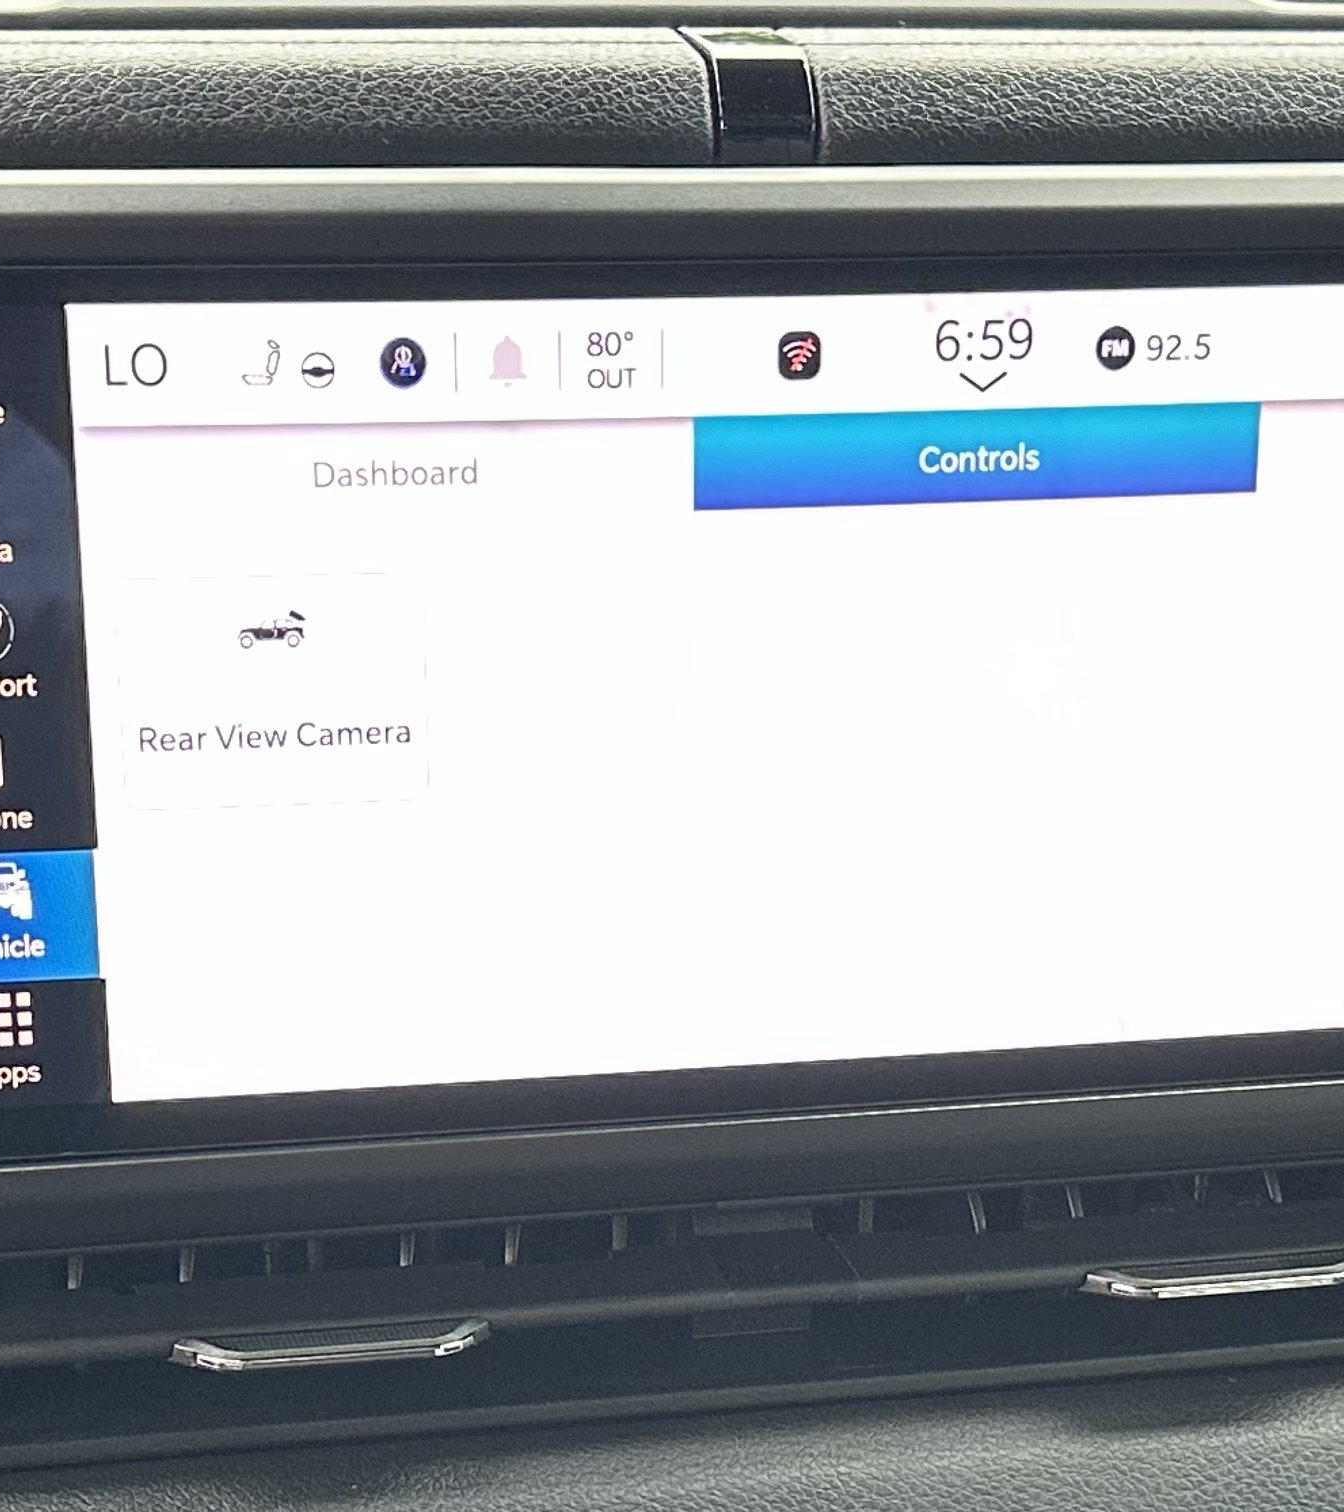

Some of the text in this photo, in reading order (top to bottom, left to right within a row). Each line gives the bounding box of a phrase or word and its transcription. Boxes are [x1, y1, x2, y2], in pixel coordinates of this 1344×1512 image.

[585, 330, 635, 358] 80°
[935, 318, 1035, 363] 6:59
[1100, 332, 1212, 363] FM 92.5
[104, 342, 168, 387] LO
[586, 367, 637, 390] OUT
[311, 456, 479, 489] Dashboard
[918, 442, 1041, 475] Controls
[138, 720, 412, 754] Rear View Camera
